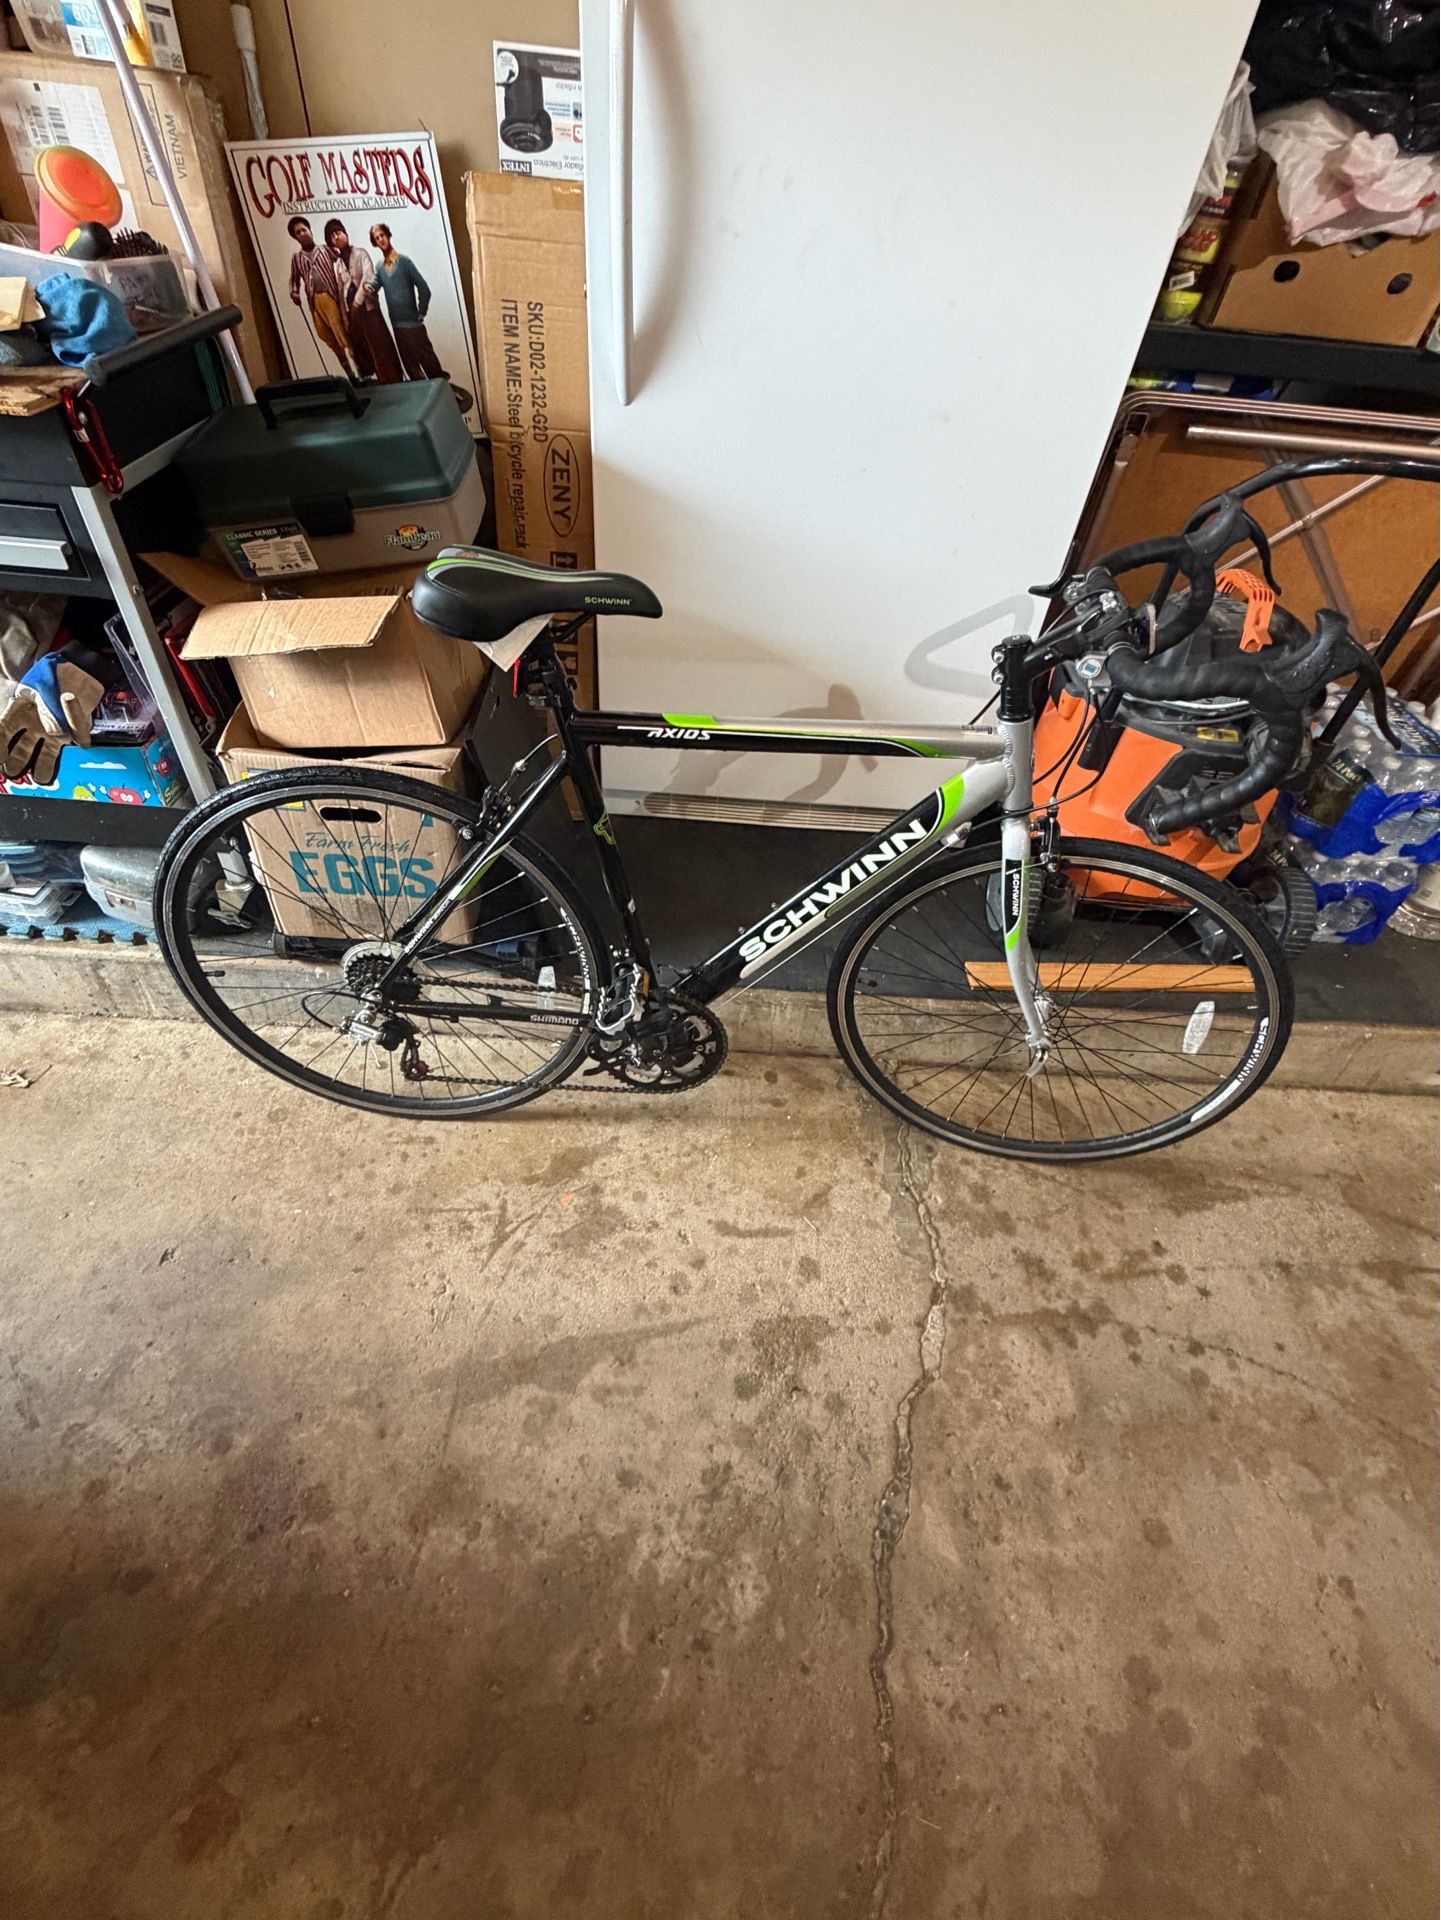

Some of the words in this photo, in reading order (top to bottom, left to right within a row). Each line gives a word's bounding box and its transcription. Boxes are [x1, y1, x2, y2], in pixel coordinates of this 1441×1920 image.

[164, 113, 188, 181] VIETNAM
[501, 160, 532, 174] INTEX
[245, 151, 315, 219] GOLF
[316, 145, 434, 211] MASTERS
[282, 198, 360, 214] INSTRUCTIONAL
[361, 195, 409, 209] ACADEMY
[500, 298, 519, 340] ITEM
[504, 342, 524, 429] NAME:Steel
[526, 300, 549, 443] SKU:D02-1232-G2D
[507, 431, 526, 480] bicycle
[551, 447, 571, 530] ZENY
[254, 527, 278, 538] SERIES
[584, 595, 631, 606] SCHWINN
[647, 727, 712, 741] AXIOS
[305, 830, 354, 851] Farm
[360, 833, 411, 852] Fresh
[288, 849, 441, 901] EGGS
[738, 817, 929, 962] SCHWINN
[1011, 872, 1021, 917] SCHWINN
[404, 918, 434, 954] SCHWINN
[529, 1013, 579, 1026] SHIMANO
